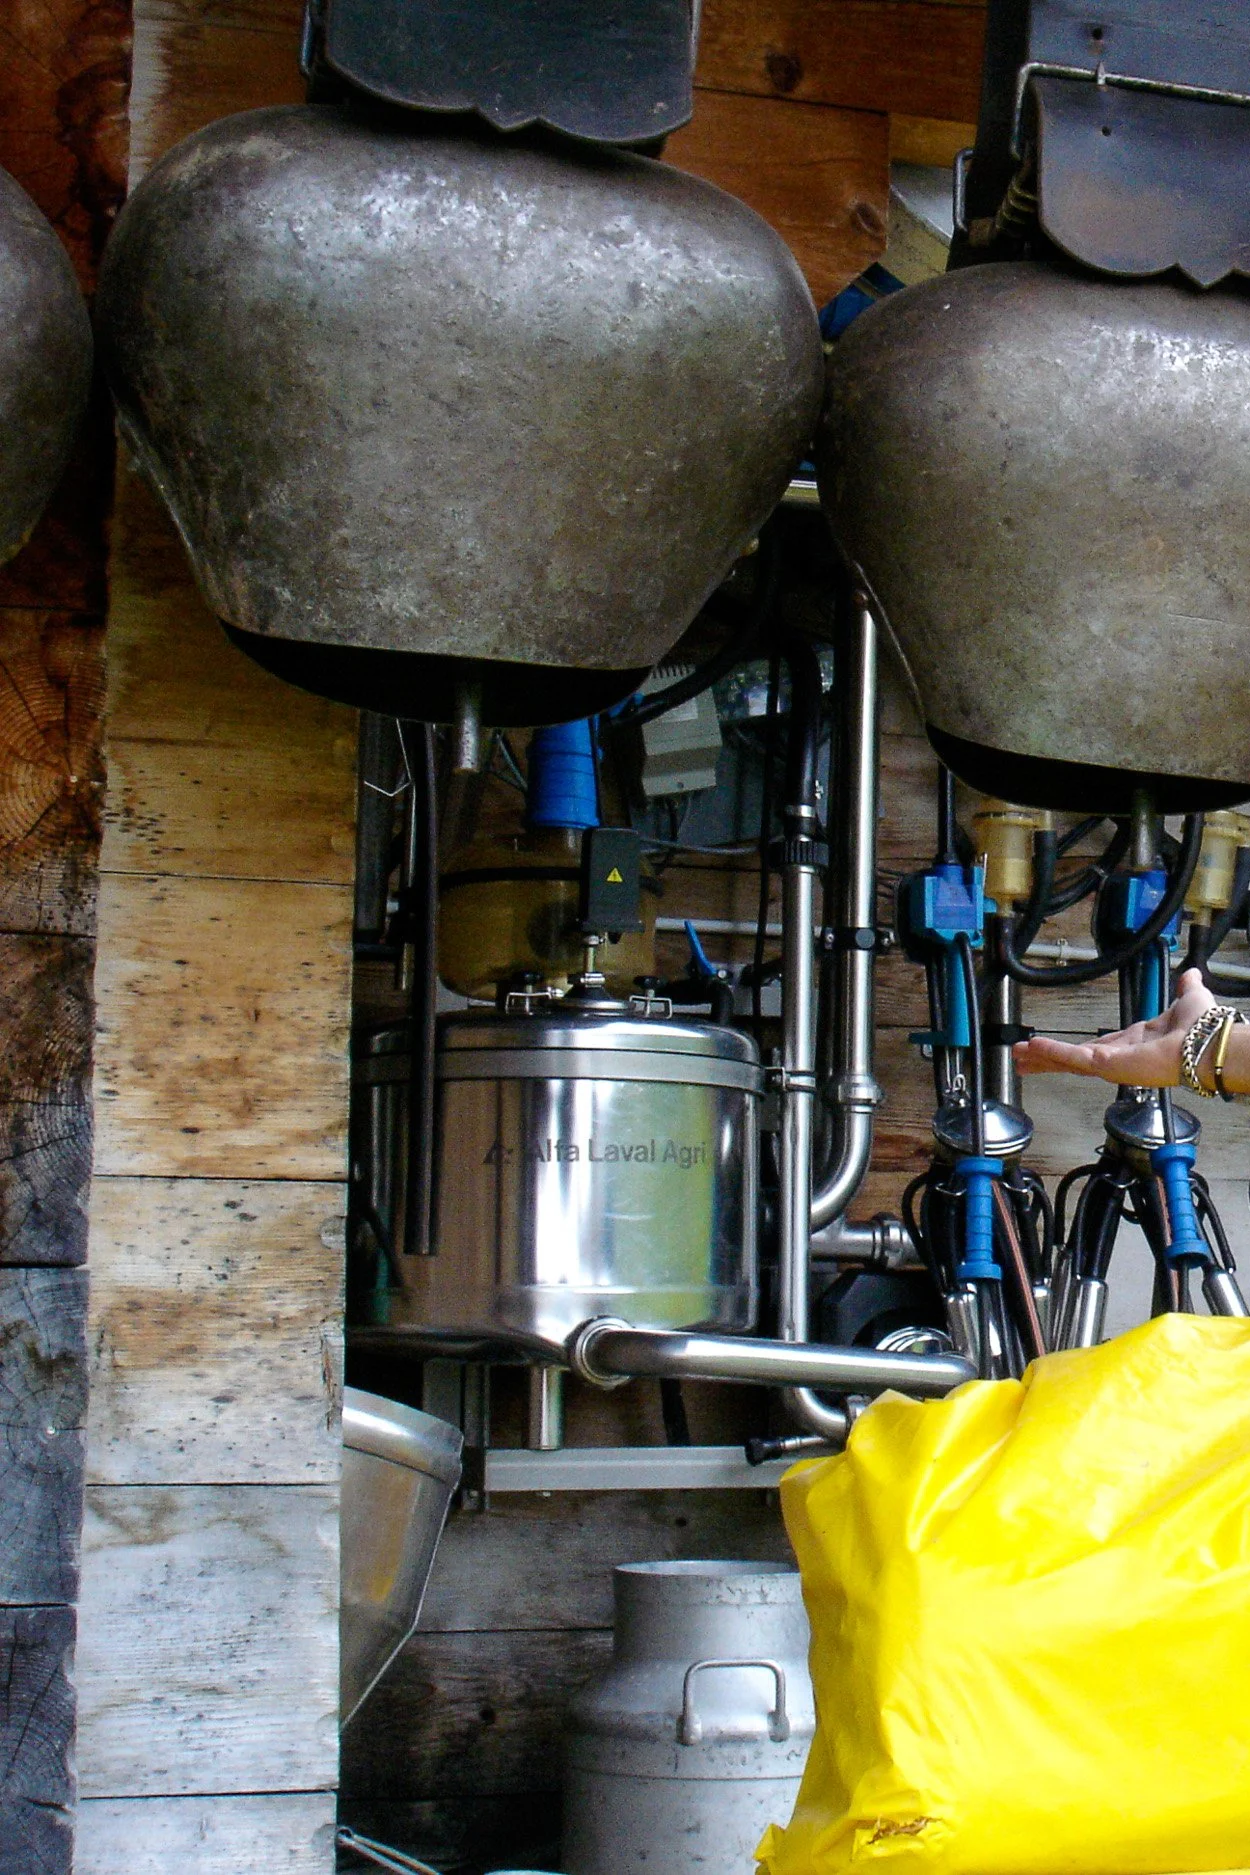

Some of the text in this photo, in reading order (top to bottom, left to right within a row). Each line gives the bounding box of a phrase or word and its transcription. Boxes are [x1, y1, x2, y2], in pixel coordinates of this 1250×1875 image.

[530, 1138, 706, 1169] Alfa Laval Agri
